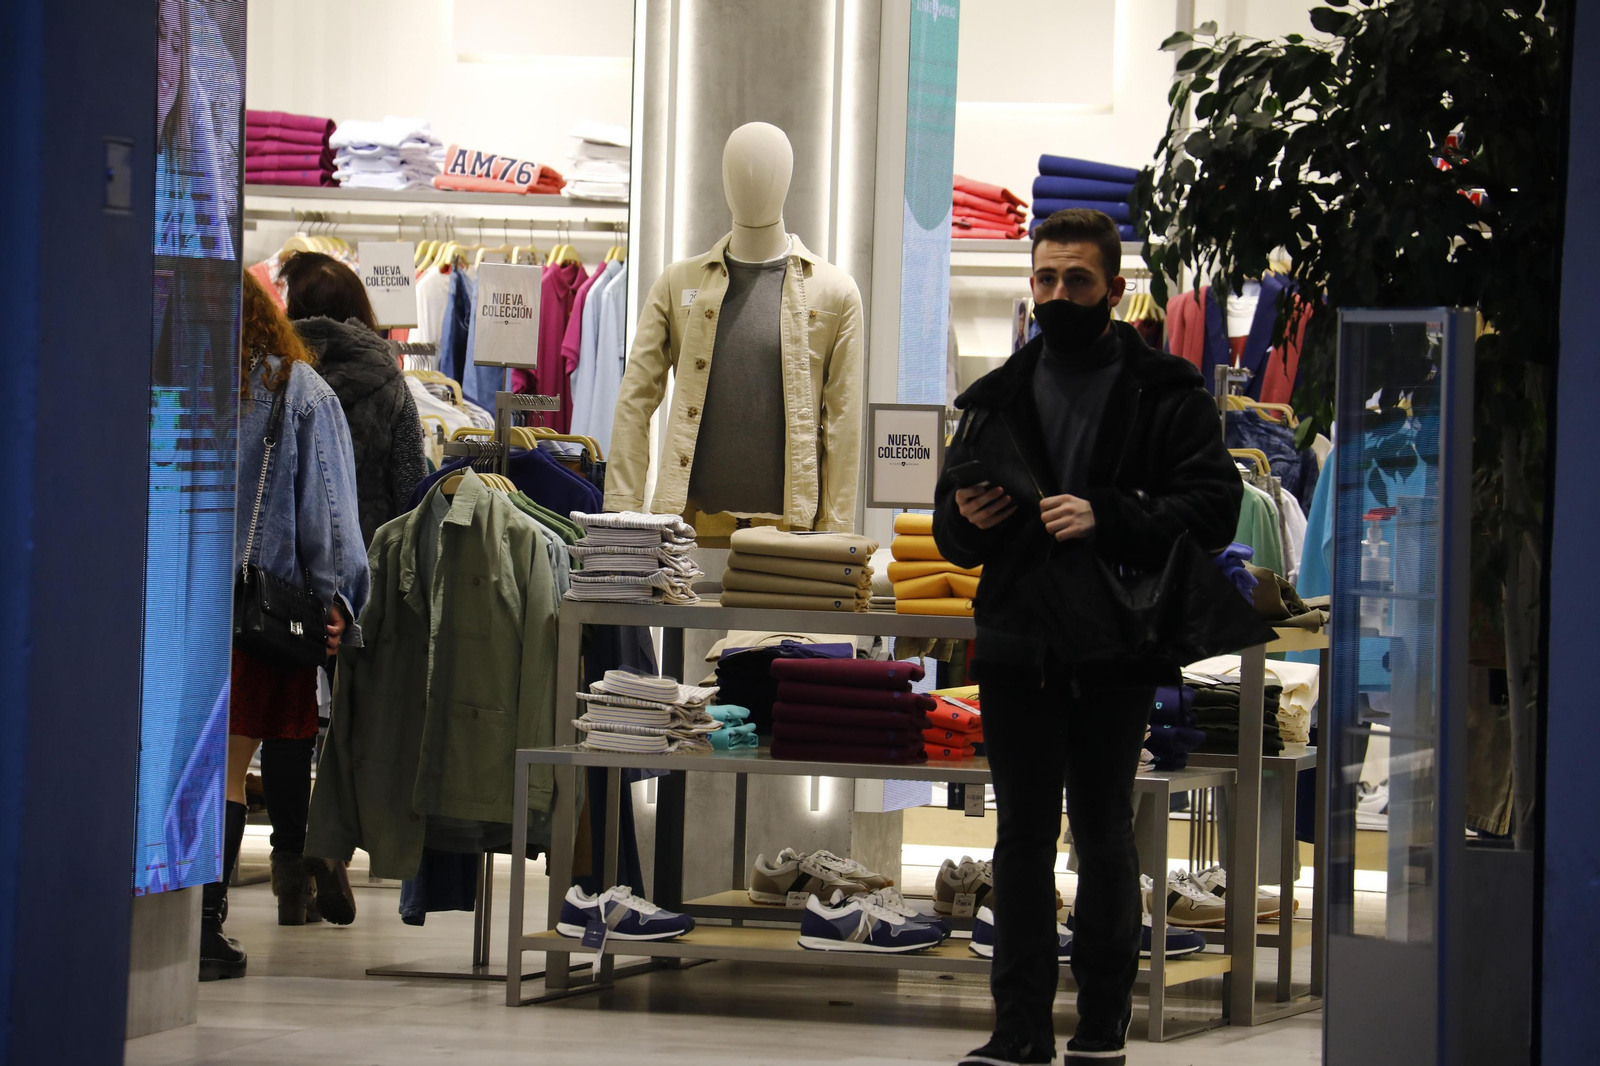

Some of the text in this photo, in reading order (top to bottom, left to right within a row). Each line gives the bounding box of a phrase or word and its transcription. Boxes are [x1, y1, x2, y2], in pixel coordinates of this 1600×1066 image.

[449, 149, 536, 185] AM76
[373, 265, 401, 276] NUEVA
[365, 274, 410, 287] COLECCIÓN
[492, 293, 524, 306] NUEVA
[482, 305, 533, 319] COLECCIÓN
[888, 434, 921, 447] NUEVA
[878, 445, 930, 460] COLECCIÓN
